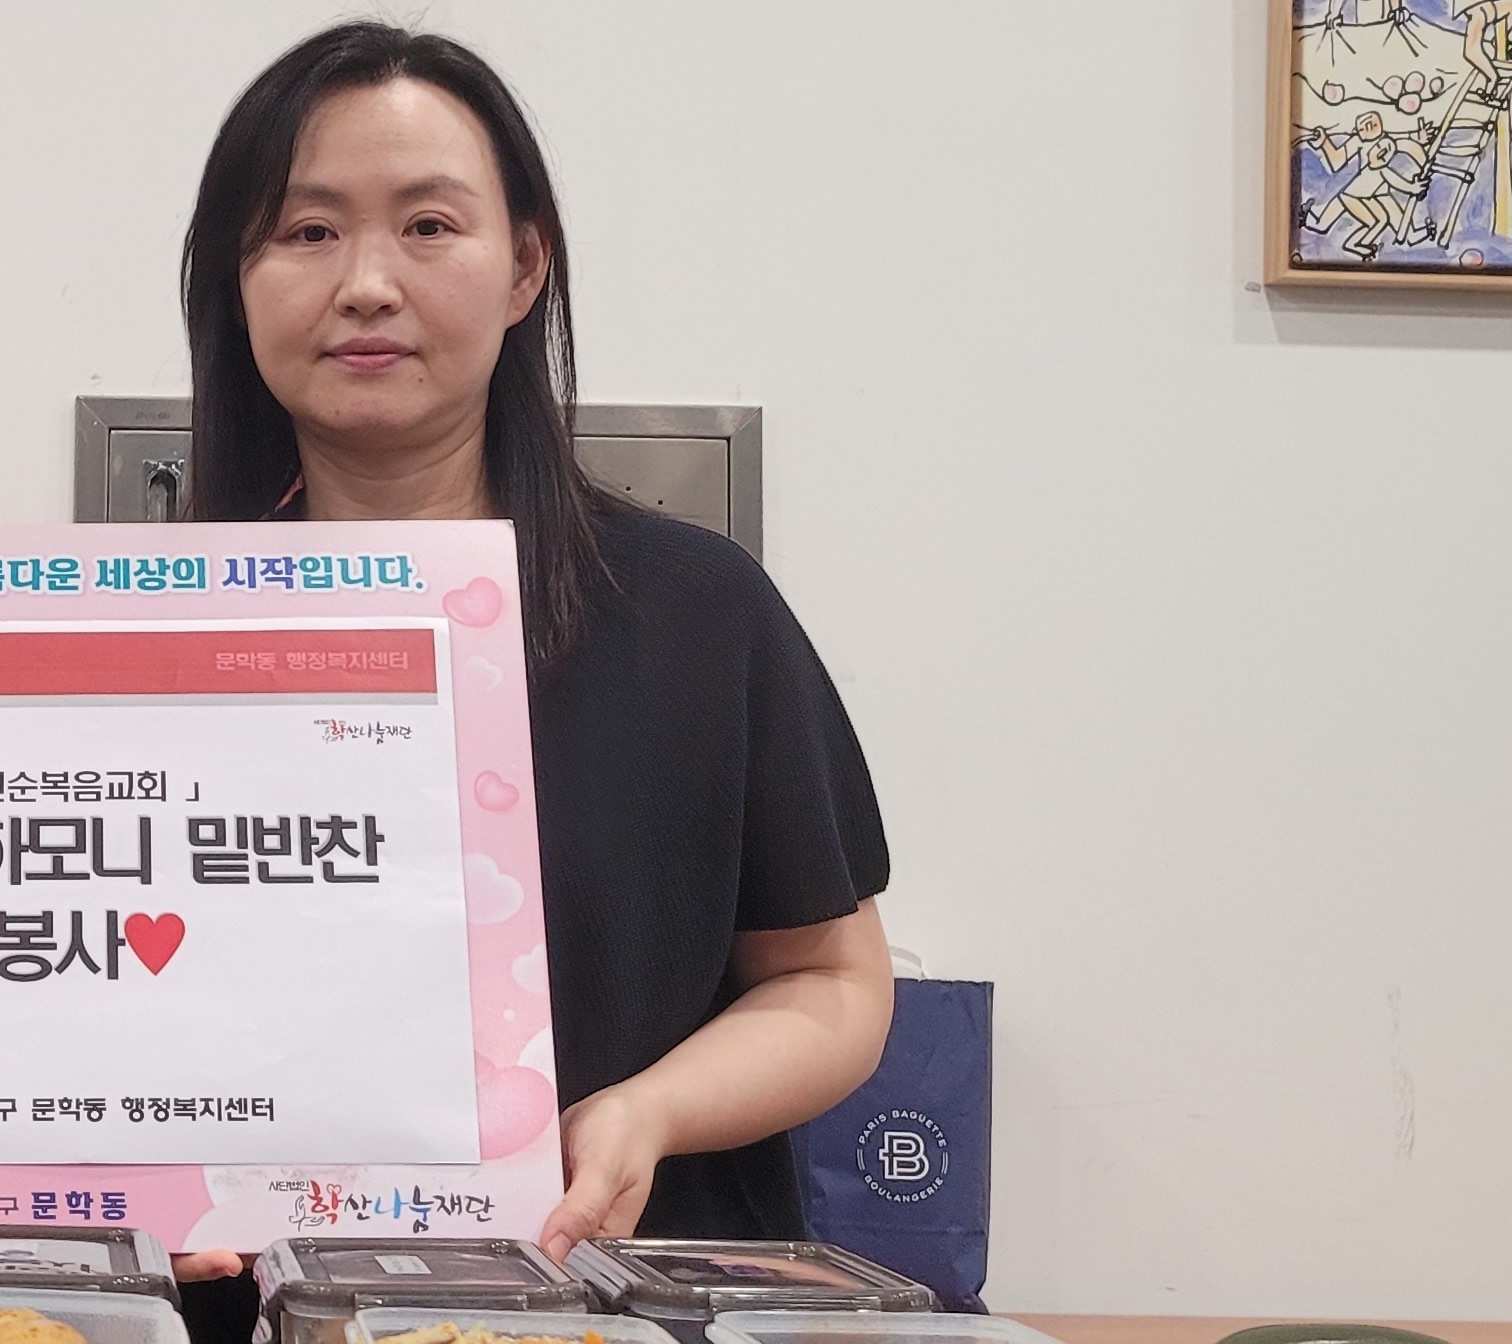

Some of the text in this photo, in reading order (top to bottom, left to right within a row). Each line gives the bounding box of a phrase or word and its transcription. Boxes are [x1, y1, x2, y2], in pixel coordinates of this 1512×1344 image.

[95, 557, 206, 591] 세상의
[222, 556, 424, 589] 시작입니다.
[215, 652, 408, 670] 문학동 행정복지센터
[187, 816, 386, 886] 밑반찬
[31, 1097, 107, 1122] 문학동
[120, 1097, 275, 1122] 행정복지센터
[858, 1113, 887, 1144] PARIS
[864, 1174, 944, 1203] BOULANGERIE
[305, 1179, 495, 1233] 학산나눔재단
